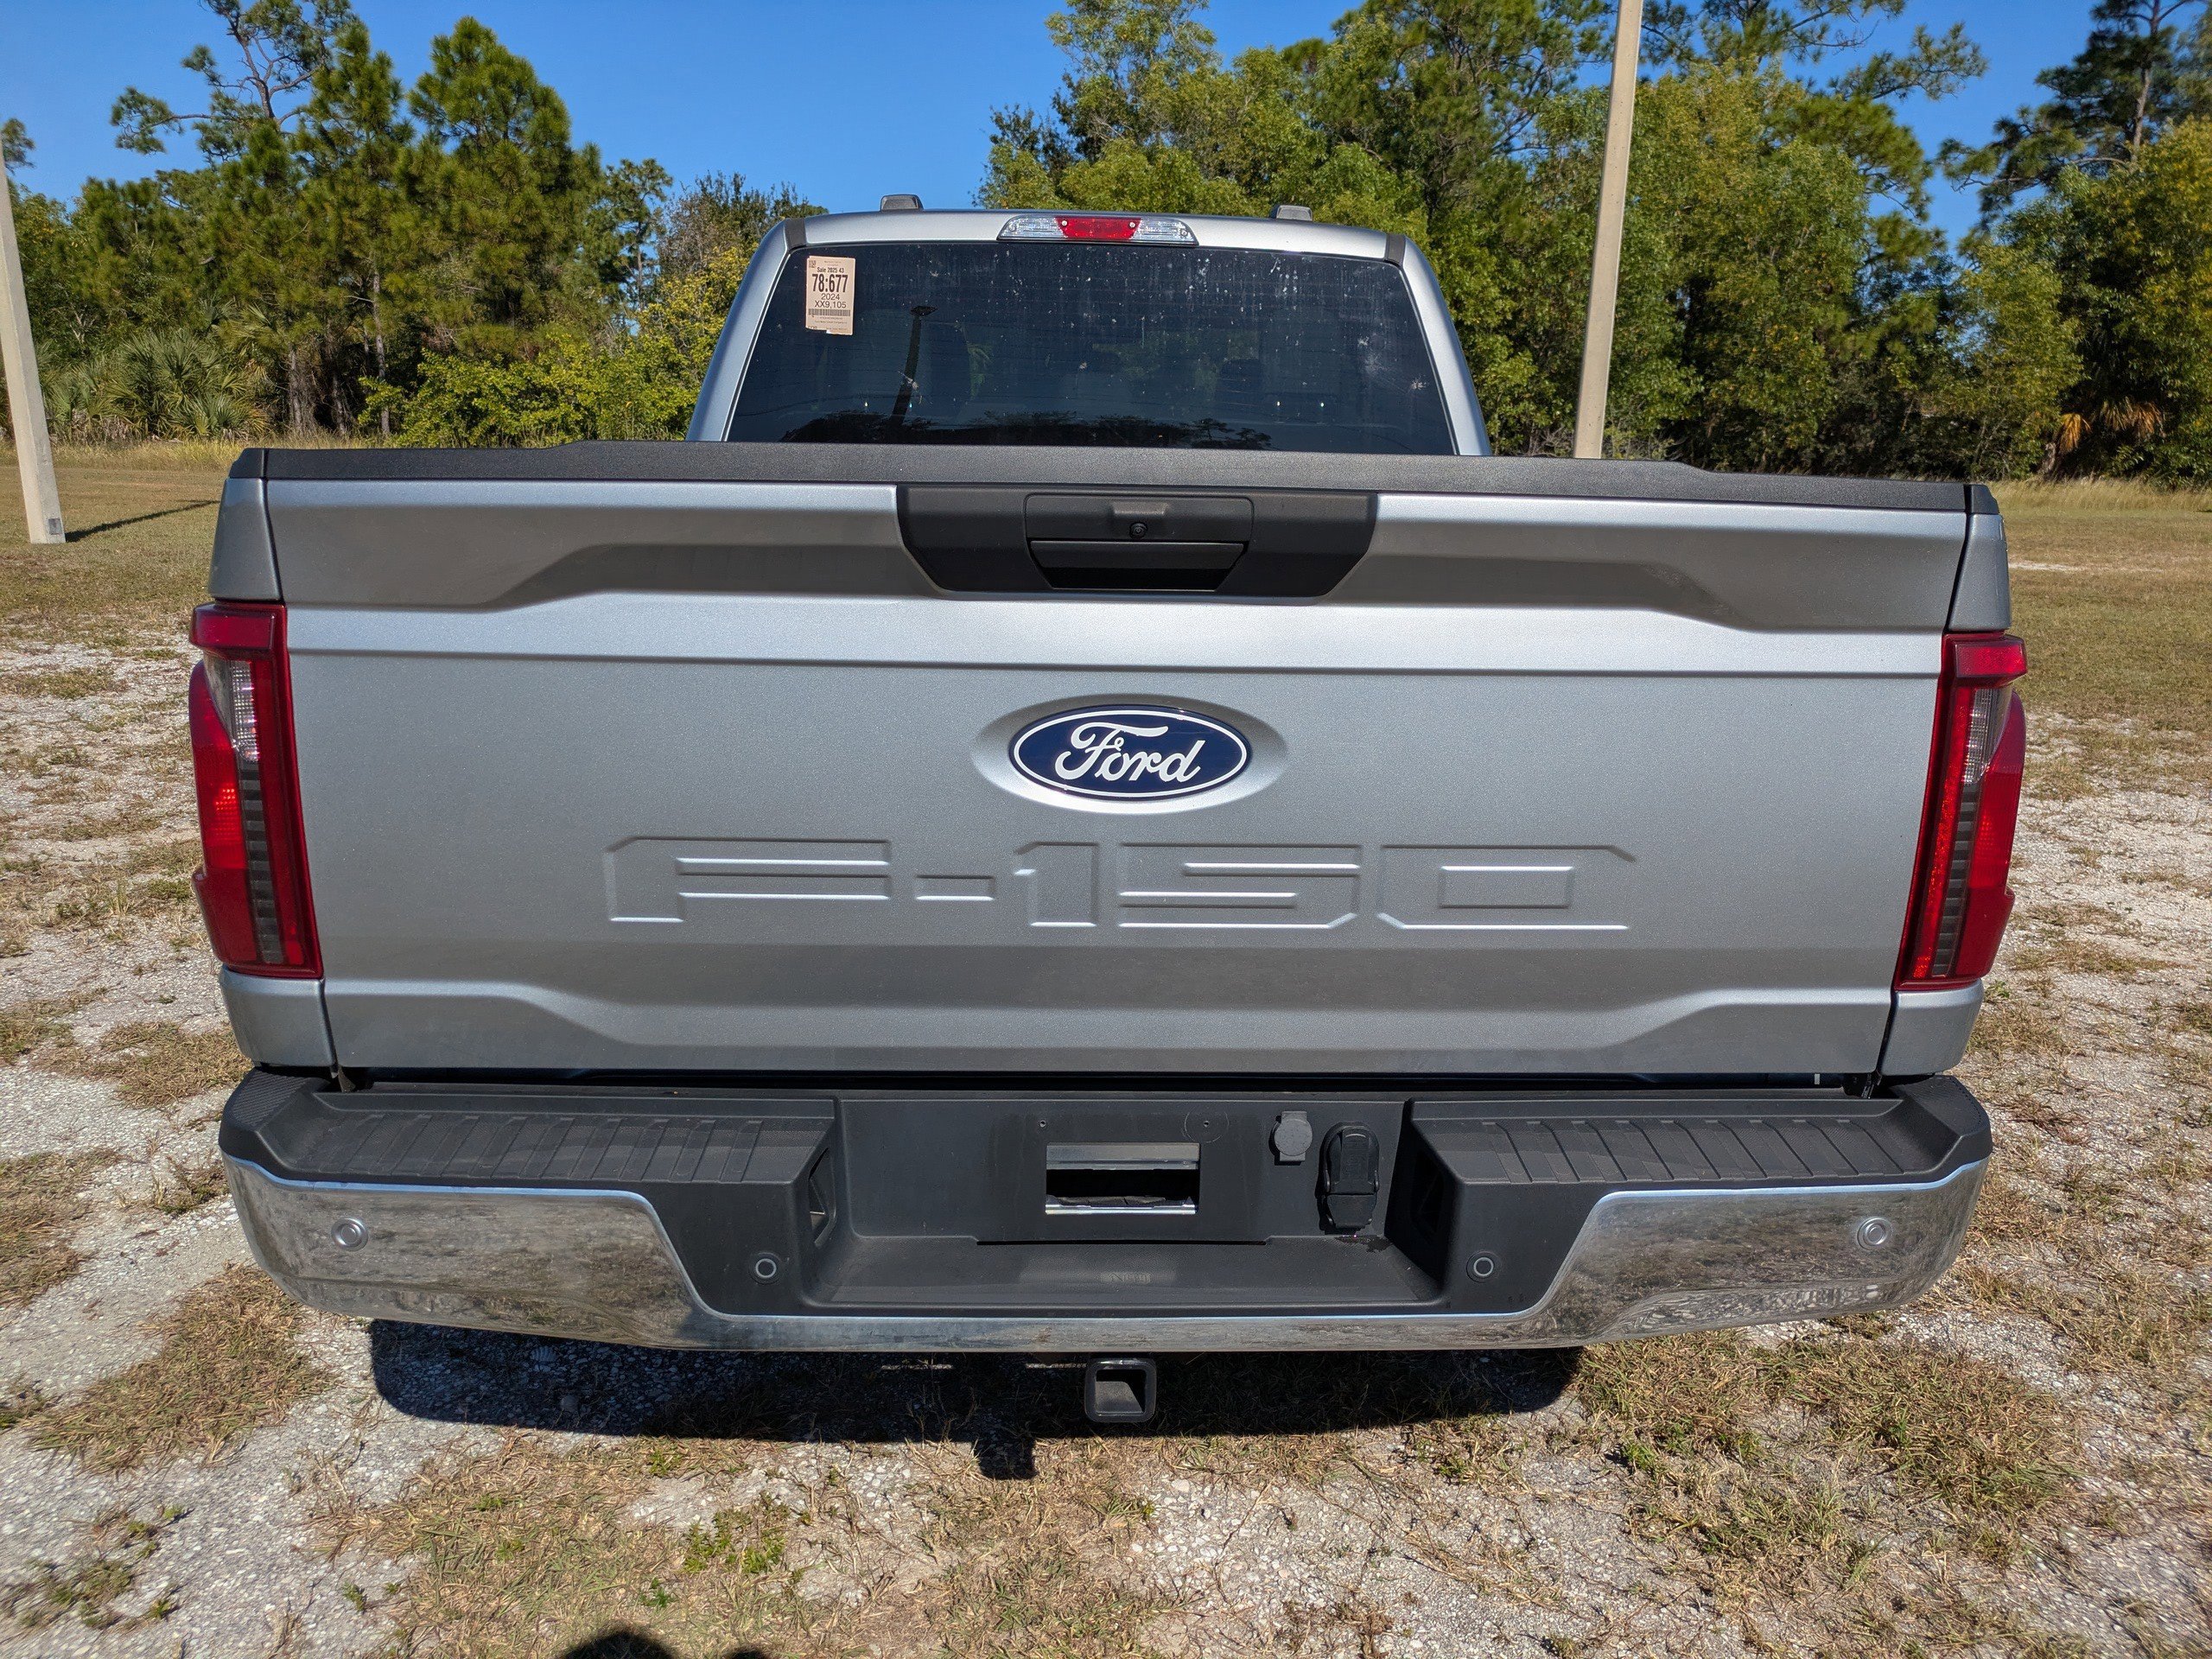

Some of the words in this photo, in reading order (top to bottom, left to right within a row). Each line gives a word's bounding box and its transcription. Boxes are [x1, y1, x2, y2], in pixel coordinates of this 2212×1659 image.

[812, 273, 848, 292] 78:677
[1054, 721, 1206, 783] Ford
[607, 835, 1637, 933] F-150
